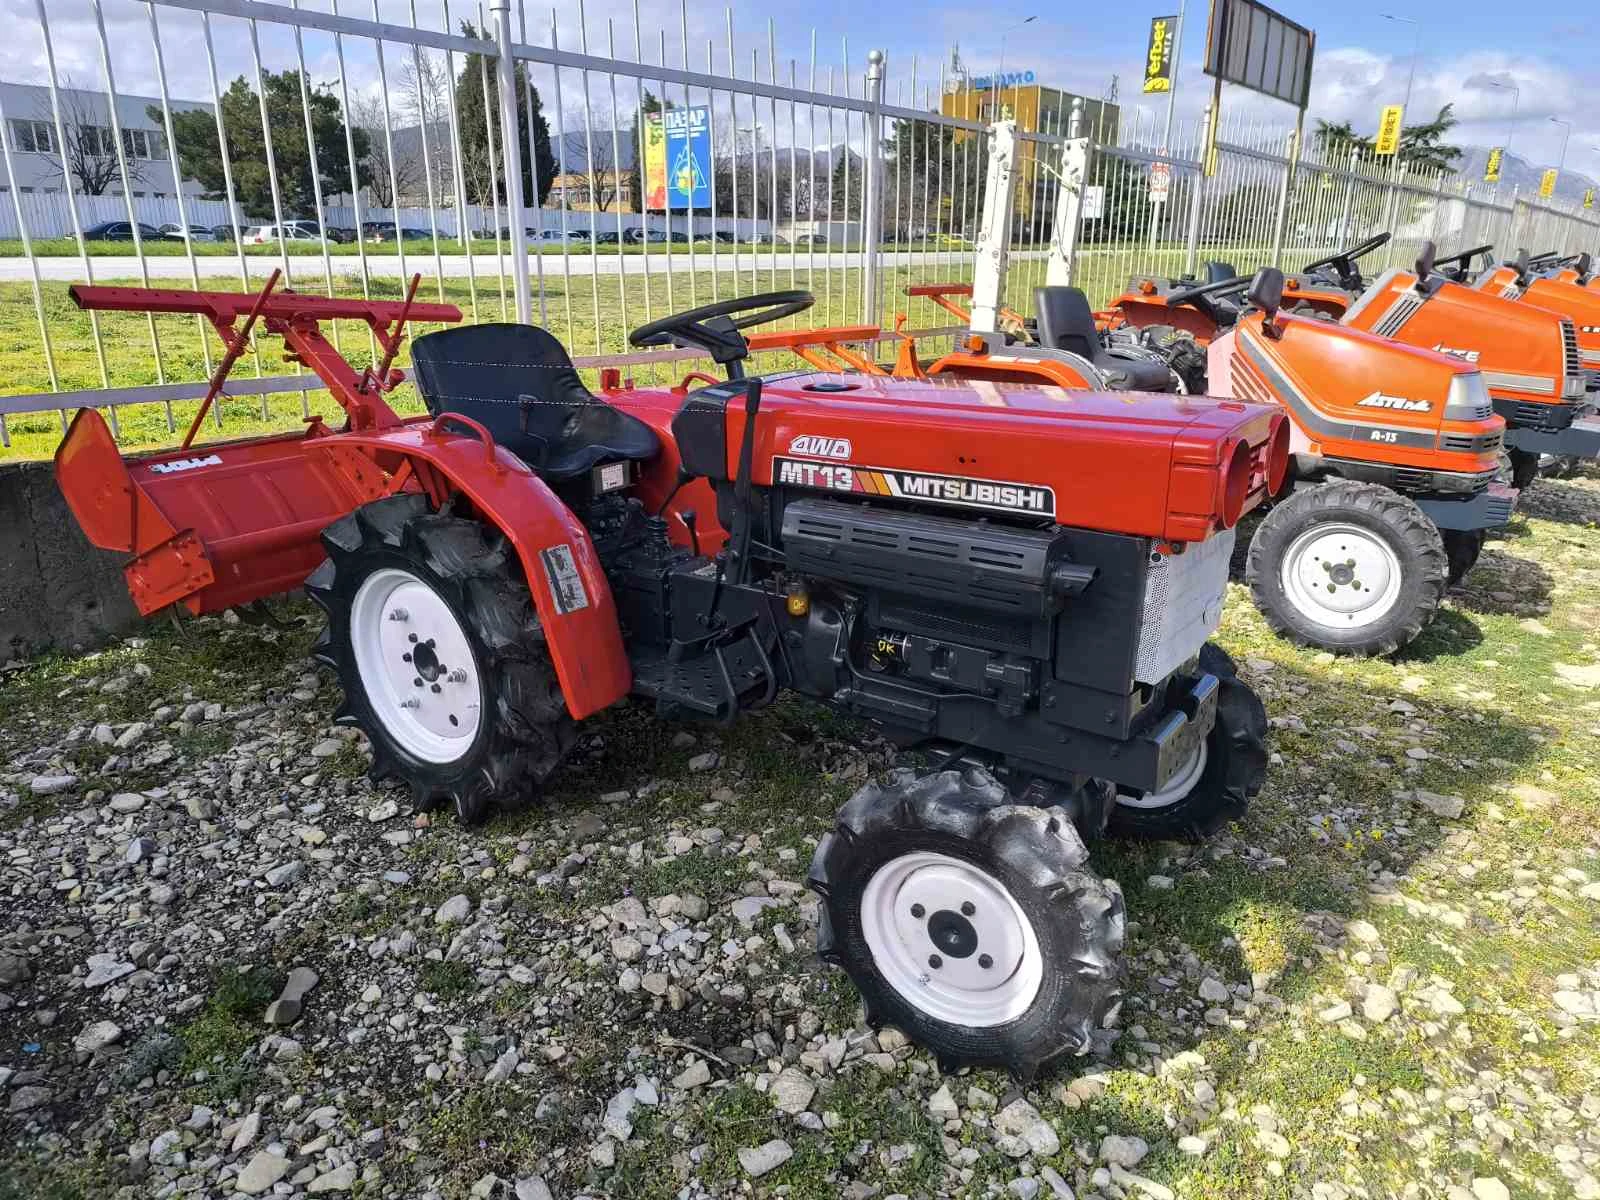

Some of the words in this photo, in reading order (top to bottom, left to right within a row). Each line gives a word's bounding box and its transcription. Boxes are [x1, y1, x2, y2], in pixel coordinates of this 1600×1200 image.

[1149, 21, 1166, 75] efbet
[790, 436, 851, 459] 4WD
[1370, 430, 1399, 442] A-15
[780, 461, 853, 491] MT13
[903, 475, 1044, 510] MITSUBISHI
[878, 639, 896, 655] OK
